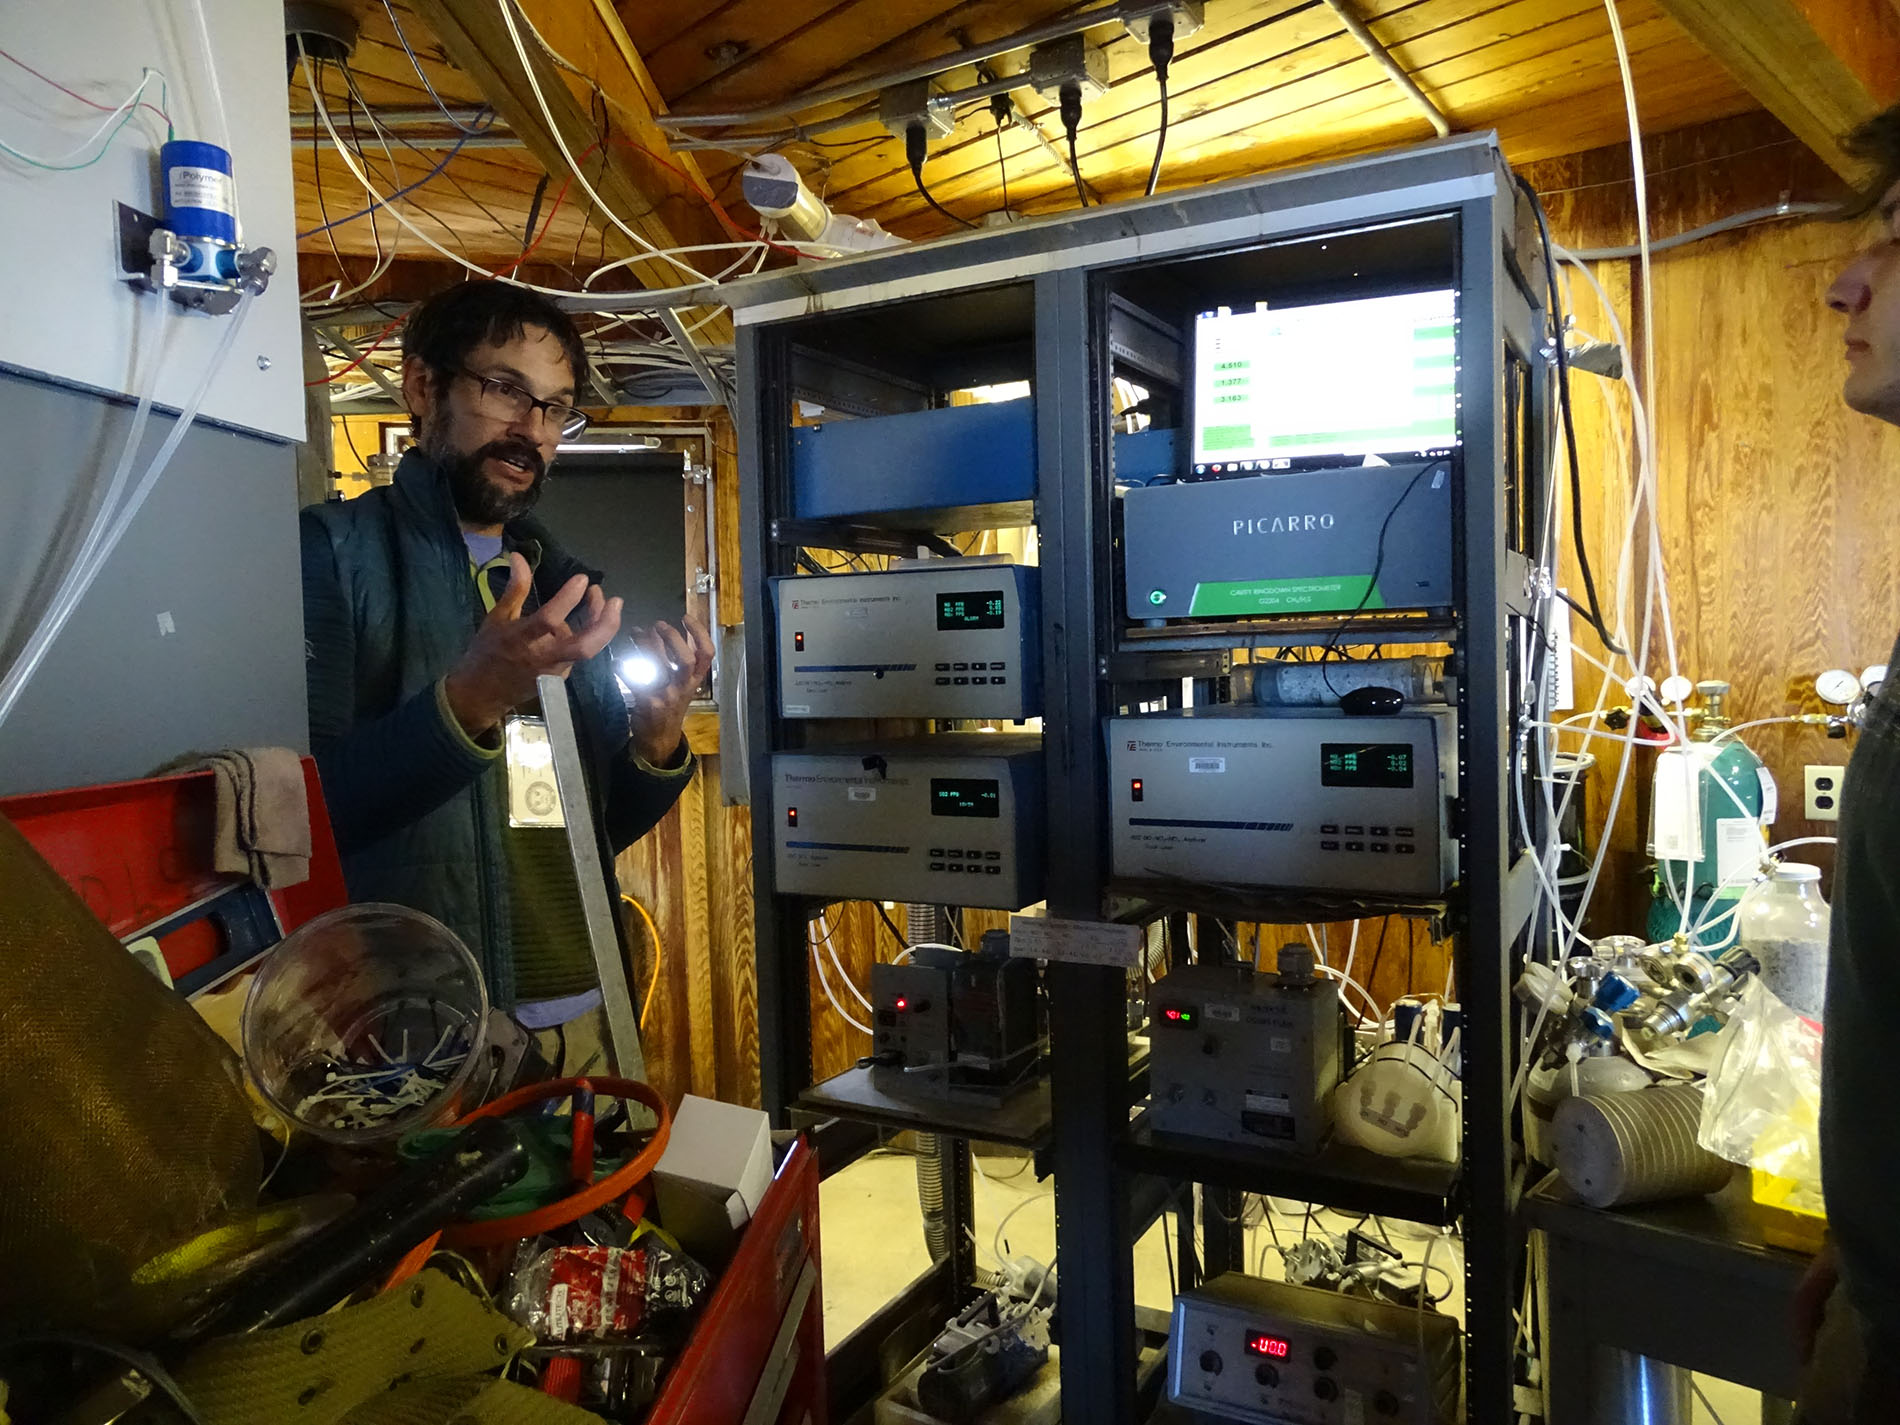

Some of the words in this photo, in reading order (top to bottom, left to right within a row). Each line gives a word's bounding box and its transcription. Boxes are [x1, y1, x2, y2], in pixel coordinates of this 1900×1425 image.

[1233, 513, 1335, 536] PICARRO
[1230, 589, 1252, 597] CAVITY
[1253, 587, 1292, 596] RINGDOWN
[1292, 584, 1342, 594] SPECTROMETER
[1138, 740, 1162, 749] Thermo
[1166, 740, 1214, 748] Environmental
[1216, 740, 1258, 749] Instruments
